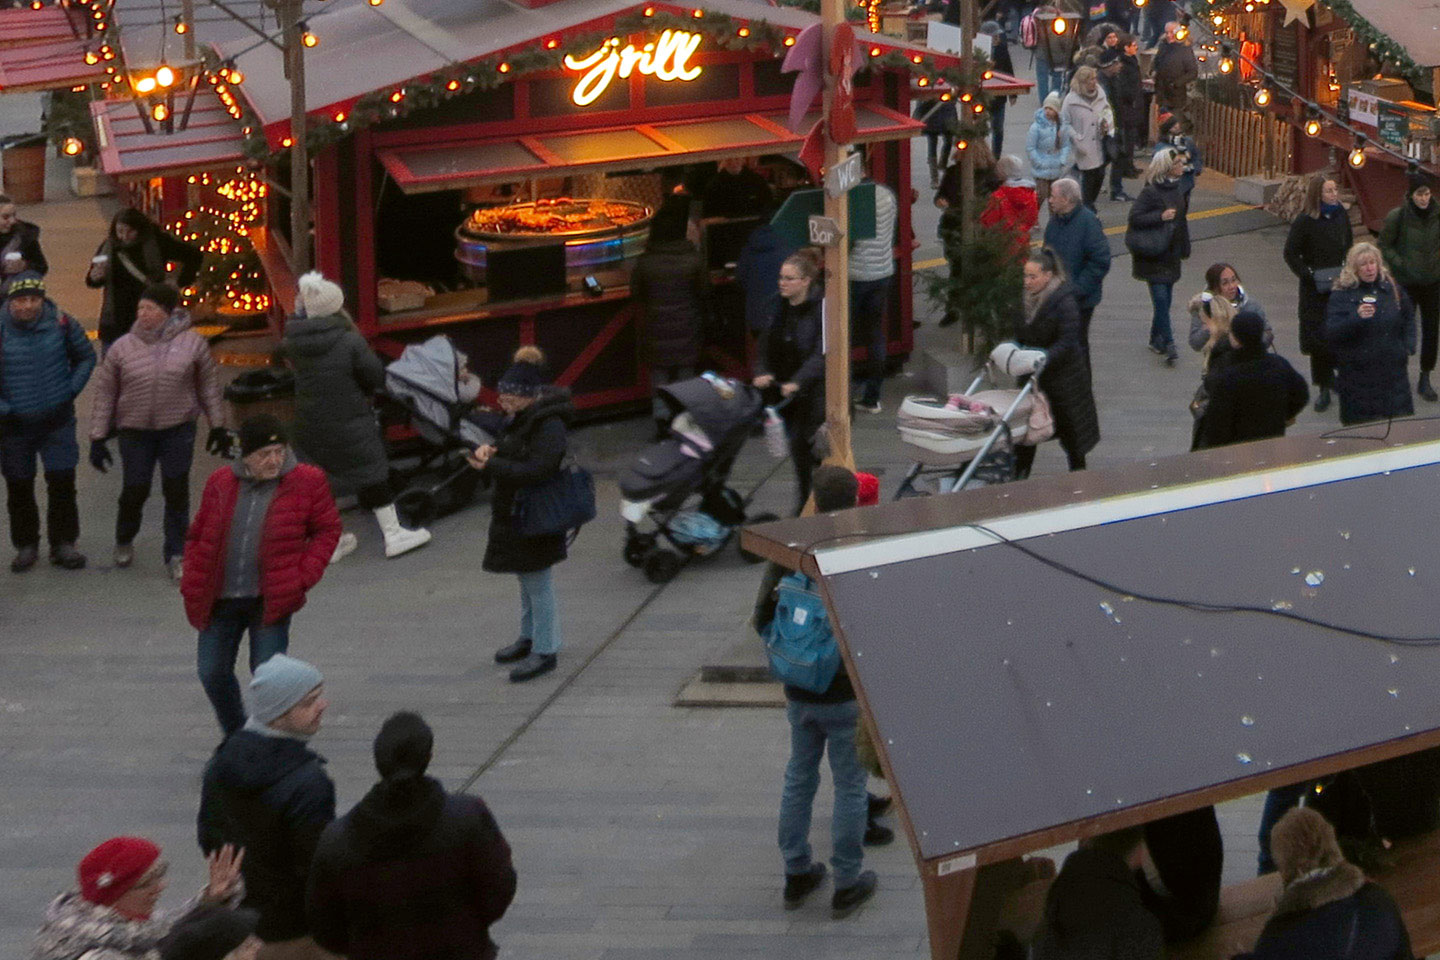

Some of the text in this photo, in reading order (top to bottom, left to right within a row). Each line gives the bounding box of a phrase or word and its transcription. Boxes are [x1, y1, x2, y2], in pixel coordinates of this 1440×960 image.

[564, 29, 702, 107] grill
[837, 159, 857, 190] WC
[809, 219, 834, 243] Bar
